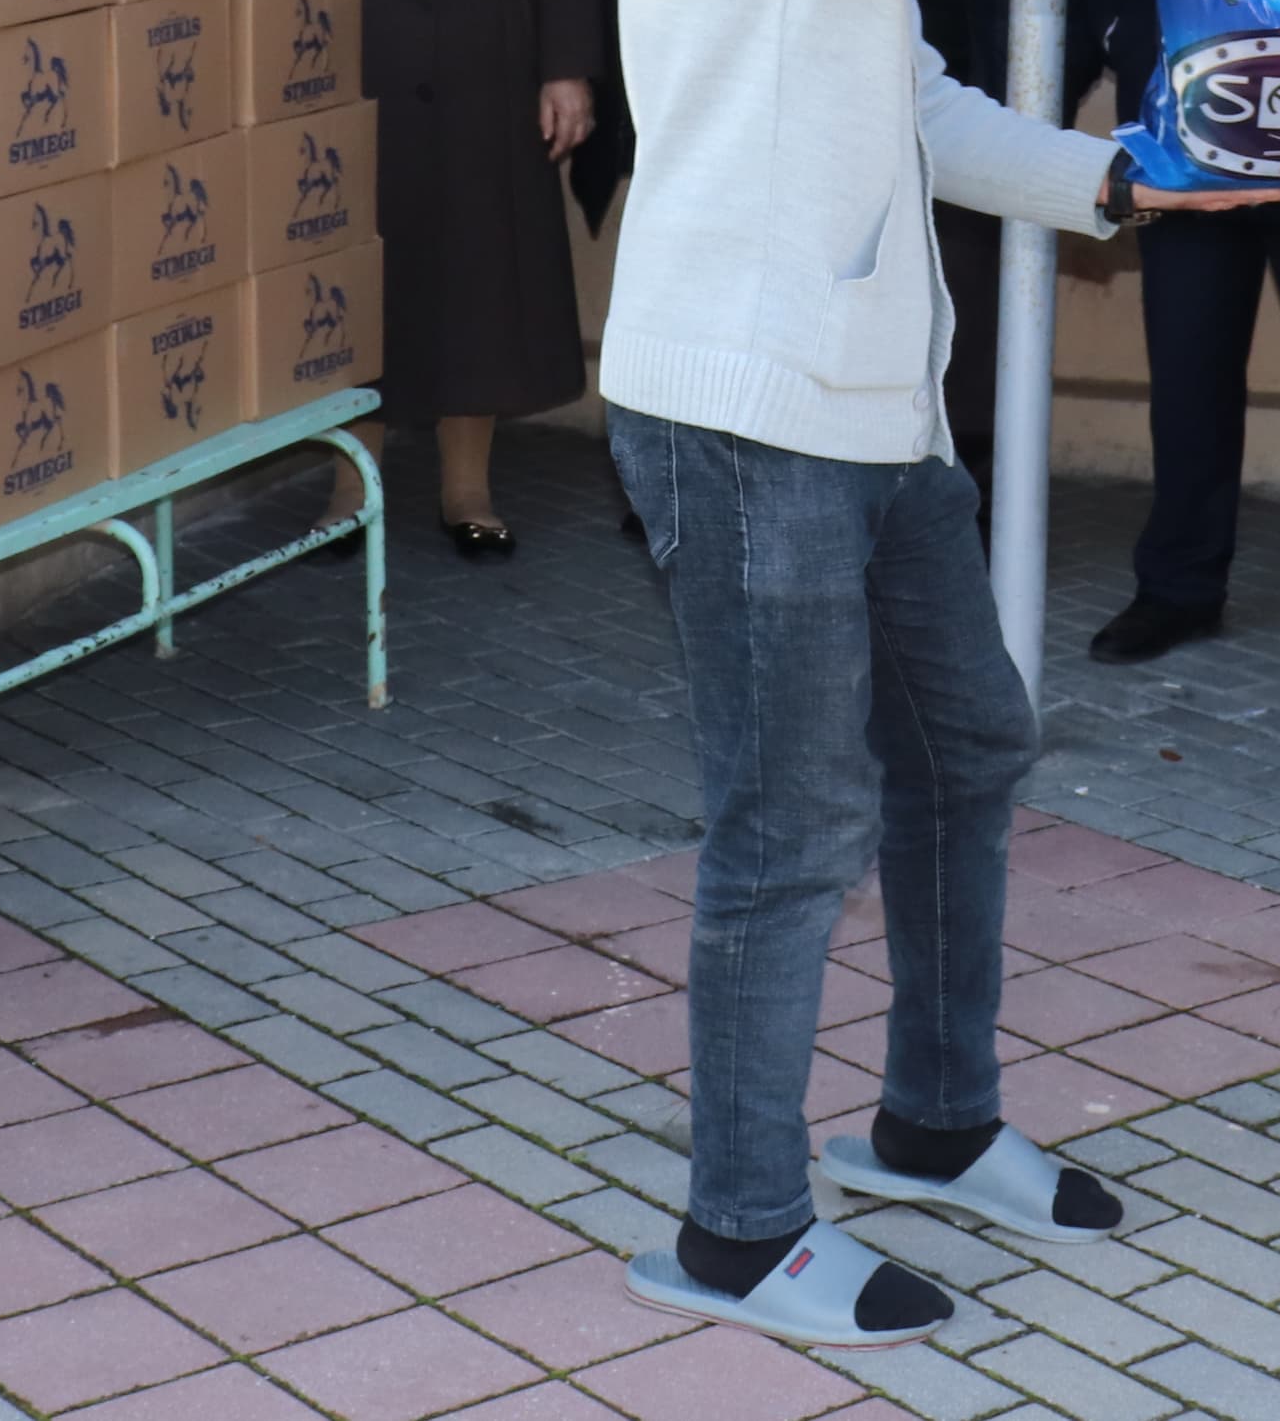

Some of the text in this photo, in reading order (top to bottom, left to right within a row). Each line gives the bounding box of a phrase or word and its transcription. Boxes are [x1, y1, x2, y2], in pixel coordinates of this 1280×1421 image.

[283, 74, 337, 104] STMEGI
[9, 130, 77, 165] STMEGI
[287, 209, 348, 241] STMEGI
[151, 244, 216, 279] STMEGI
[18, 290, 82, 329] STMEGI
[152, 316, 213, 355] STMEGI
[294, 347, 353, 382] STMEGI
[4, 453, 73, 496] STMEGI
